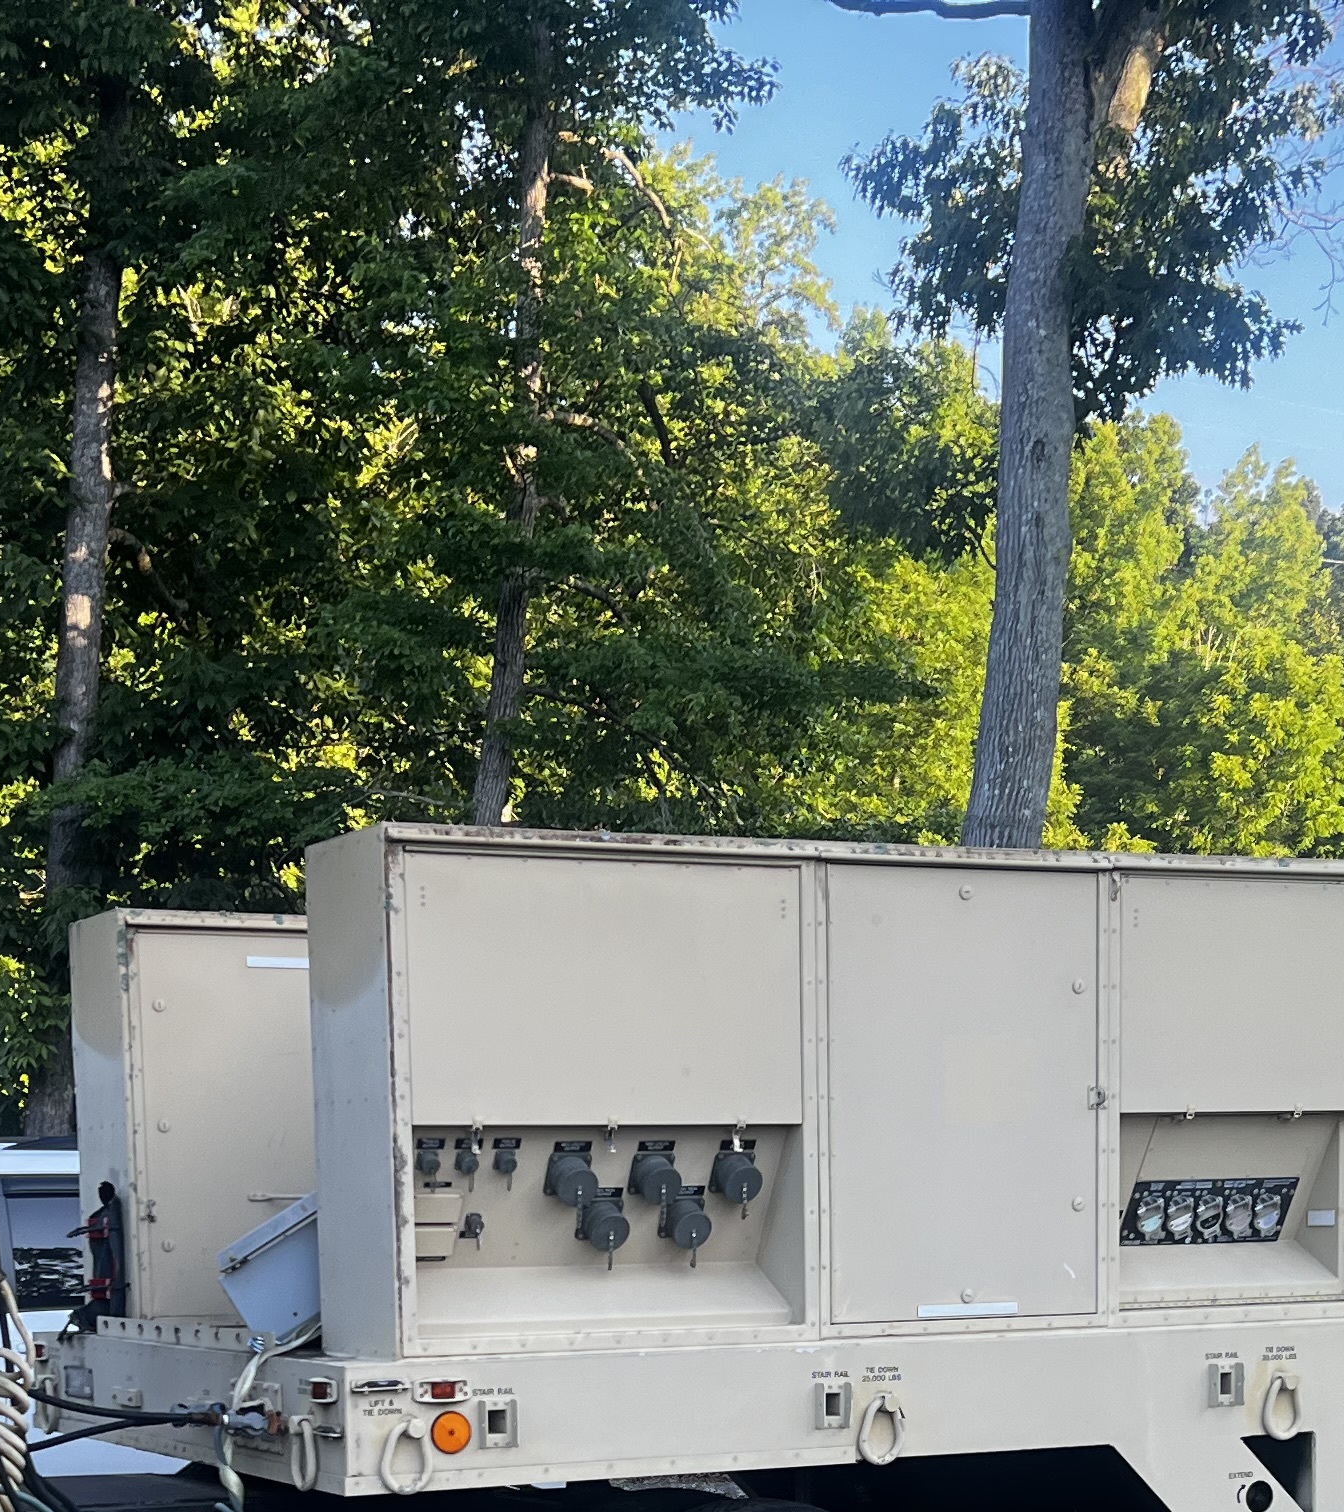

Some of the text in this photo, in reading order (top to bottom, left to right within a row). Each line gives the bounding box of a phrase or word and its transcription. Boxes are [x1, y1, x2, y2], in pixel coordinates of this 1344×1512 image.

[834, 1370, 850, 1378] RAIL
[888, 1373, 902, 1381] LBS
[472, 1387, 515, 1396] STAIR RAIL
[377, 1408, 403, 1416] DOWN
